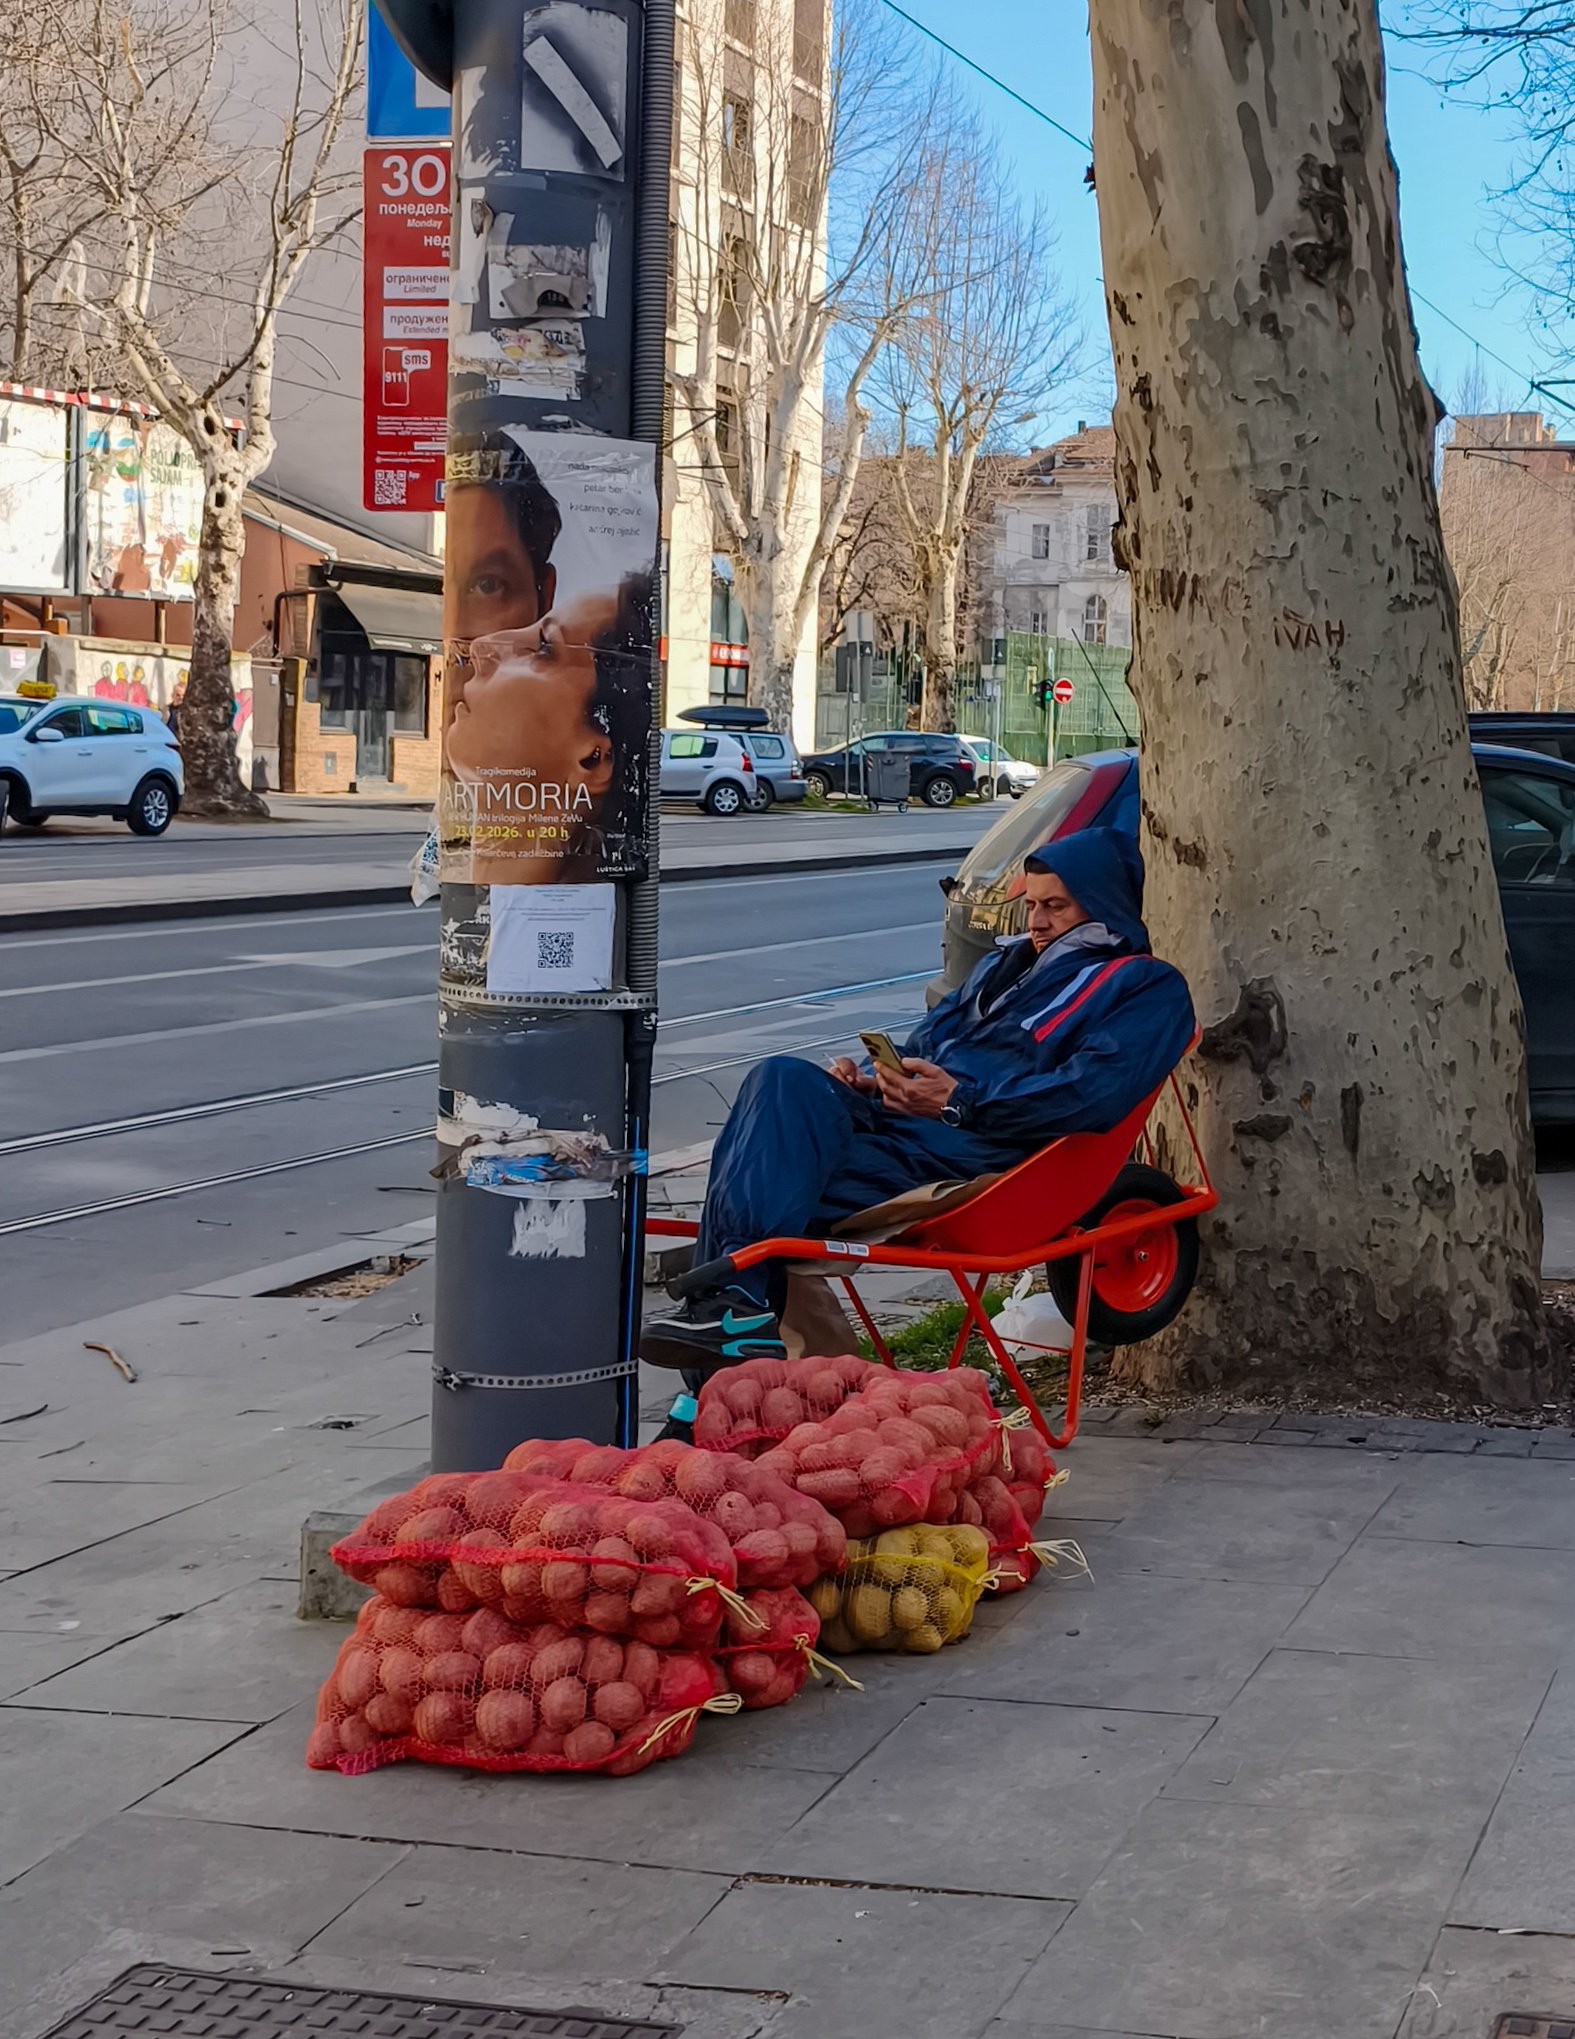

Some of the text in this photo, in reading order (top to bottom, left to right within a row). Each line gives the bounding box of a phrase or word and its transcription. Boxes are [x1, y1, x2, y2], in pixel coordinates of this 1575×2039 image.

[381, 154, 447, 197] 30
[379, 203, 452, 216] понедељ
[407, 219, 443, 230] Monday
[403, 284, 437, 294] Limited
[404, 354, 429, 365] sms
[475, 766, 537, 779] Tragikomedija
[527, 829, 535, 838] u
[539, 826, 557, 838] 20
[560, 826, 569, 839] h
